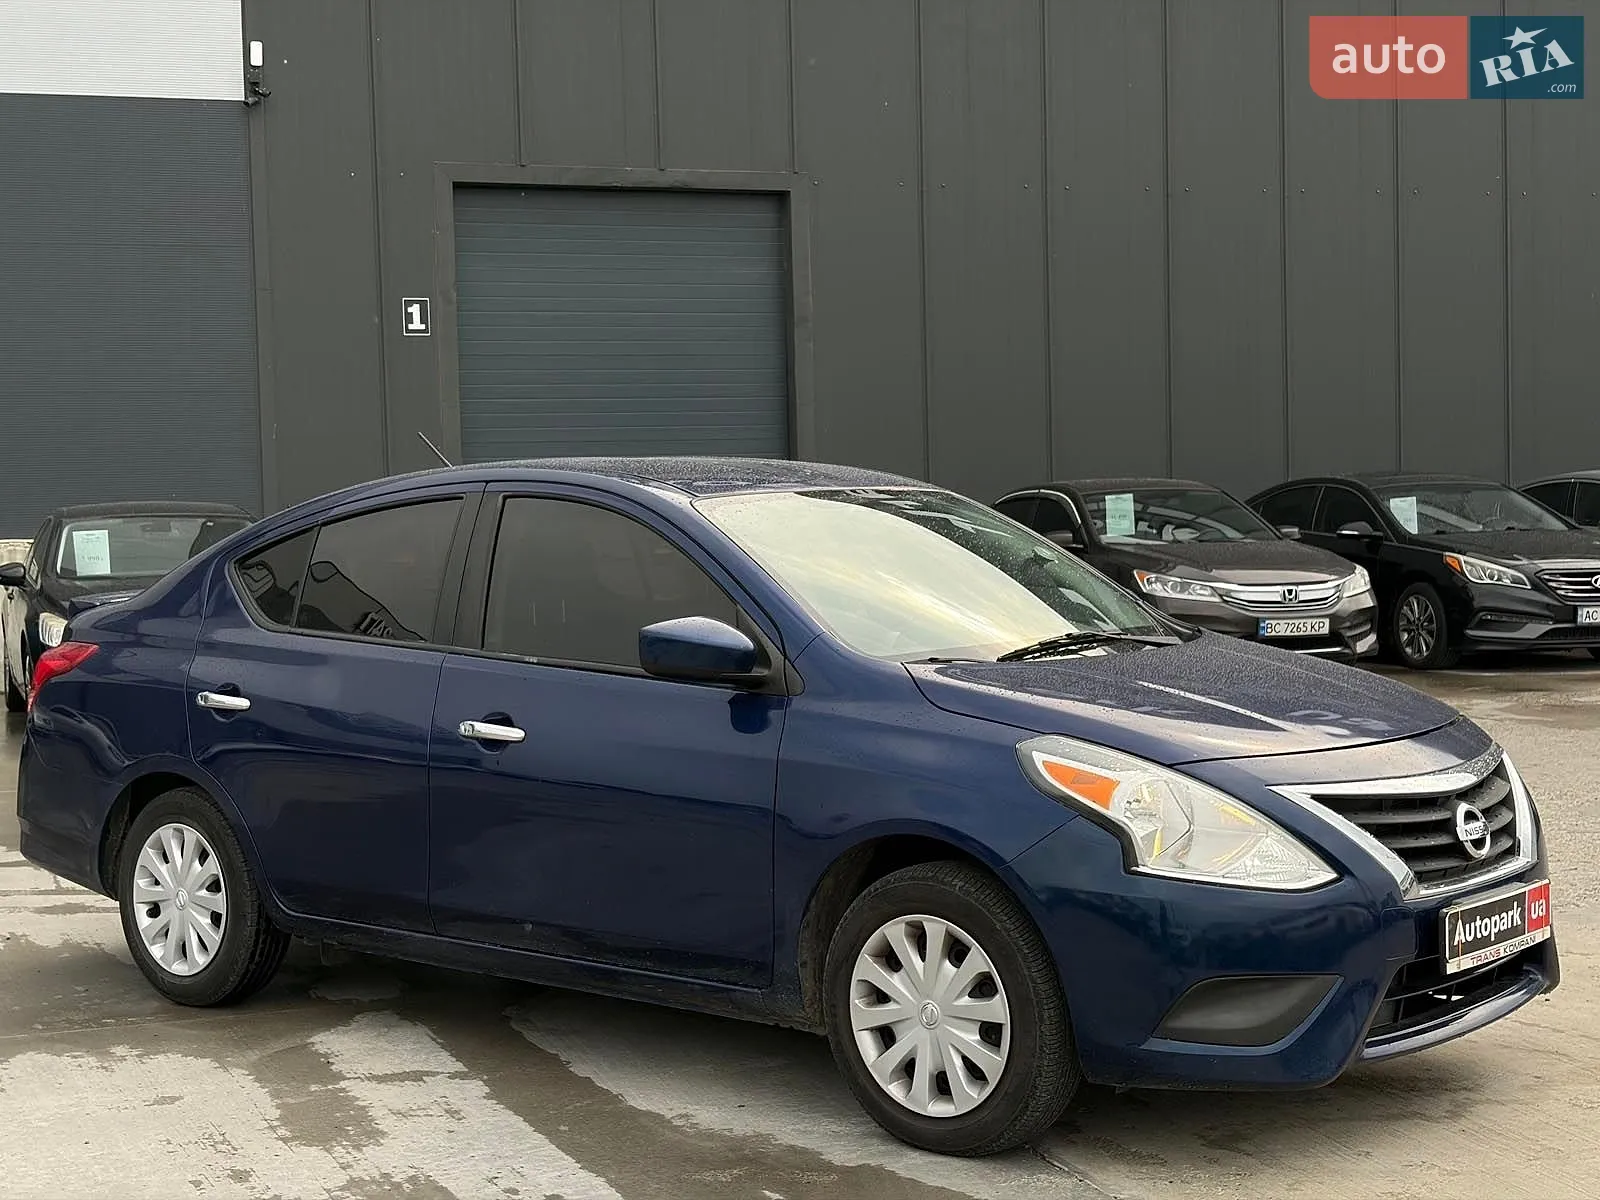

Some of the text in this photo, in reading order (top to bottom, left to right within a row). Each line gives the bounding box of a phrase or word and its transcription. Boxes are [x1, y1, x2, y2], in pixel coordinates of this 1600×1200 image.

[408, 303, 425, 330] 1
[1584, 610, 1599, 622] AC
[1265, 620, 1325, 634] BC 7265 KP
[1453, 898, 1546, 946] Autopark ua
[1470, 949, 1501, 966] TRANS
